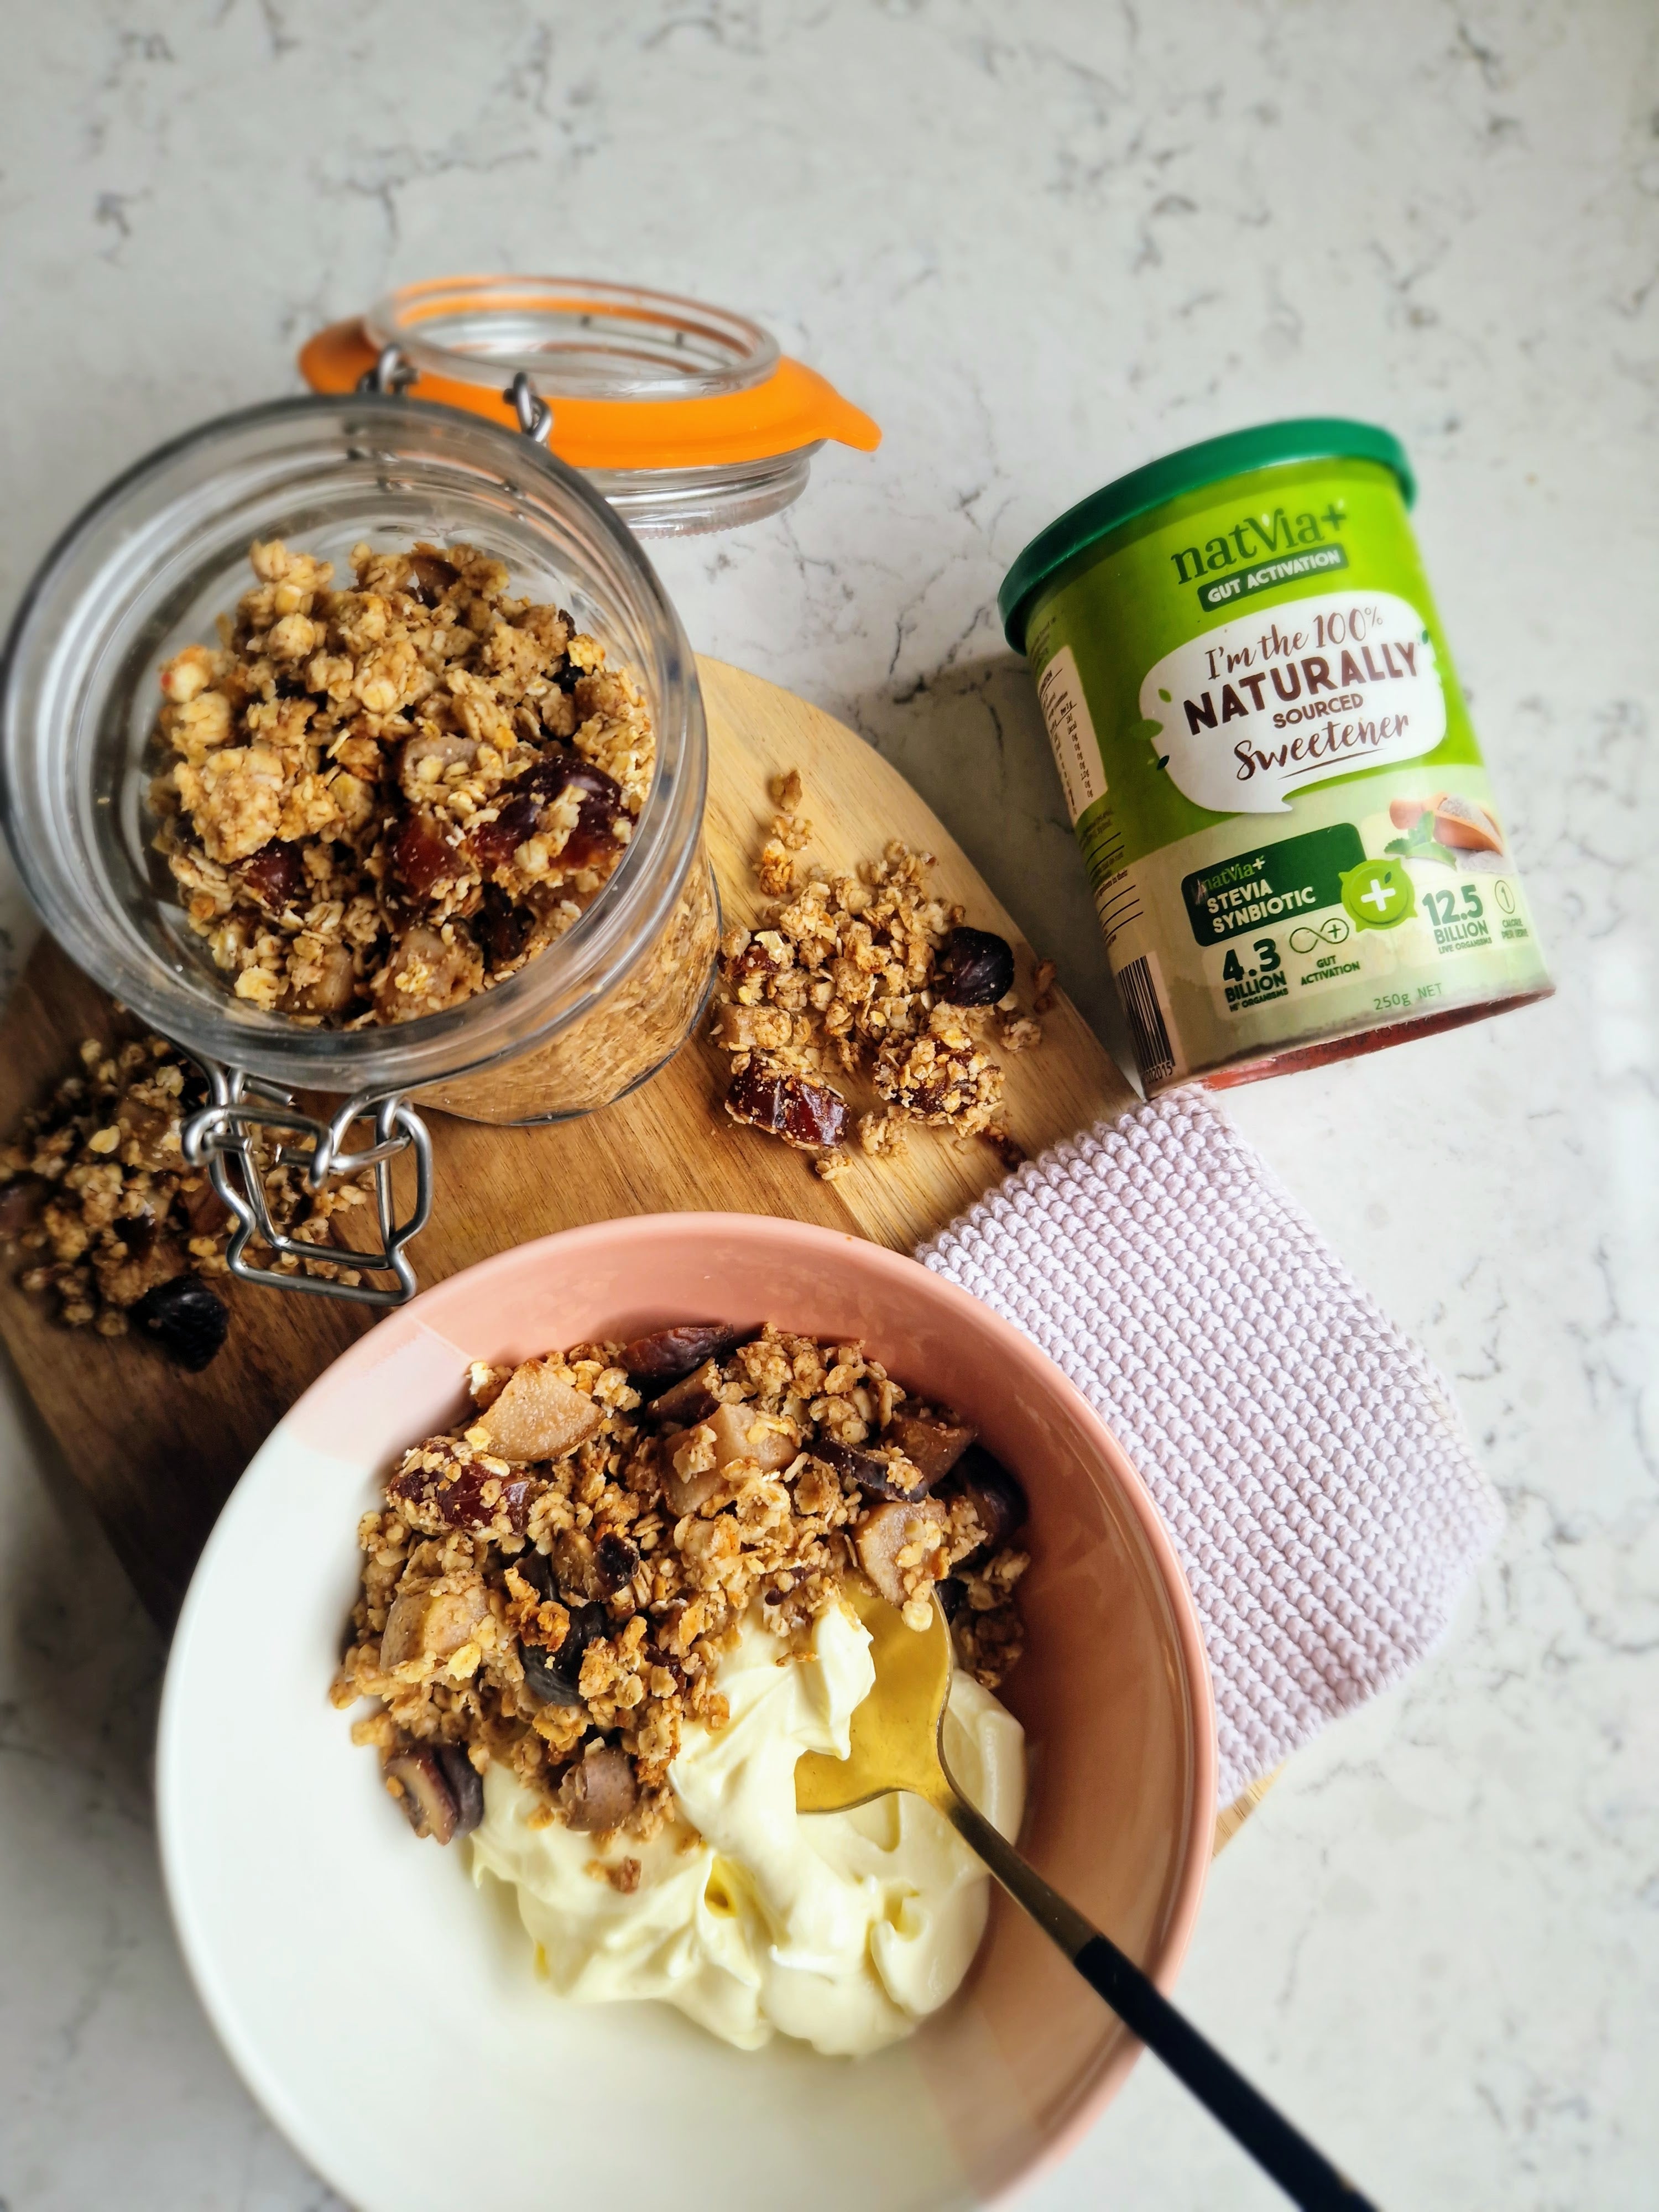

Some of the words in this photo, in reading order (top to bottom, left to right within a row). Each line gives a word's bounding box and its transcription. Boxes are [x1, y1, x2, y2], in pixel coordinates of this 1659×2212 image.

[1208, 579, 1240, 602] GUT
[1248, 550, 1340, 589] ACTIVATION
[1205, 646, 1256, 680] I'm
[1258, 624, 1308, 660] the
[1313, 606, 1383, 648] 100%
[1183, 642, 1417, 735] NATURALLY
[1274, 693, 1363, 728] SOURCED
[1234, 714, 1408, 781] Sweetener
[1207, 879, 1273, 913] STEVIA
[1213, 886, 1316, 933] SYNBIOTIC
[1422, 884, 1483, 926] 12.5
[1433, 920, 1489, 945] BILLION
[1438, 945, 1454, 954] LIVE
[1455, 937, 1492, 950] ORGANISMS
[1223, 938, 1281, 982] 4.3
[1301, 961, 1360, 985] ACTIVATION
[1317, 955, 1337, 968] GUT
[1225, 971, 1287, 1003] BILLION
[1241, 988, 1288, 1008] ORGANISMS
[1374, 993, 1411, 1010] 250g
[1417, 983, 1442, 999] NET
